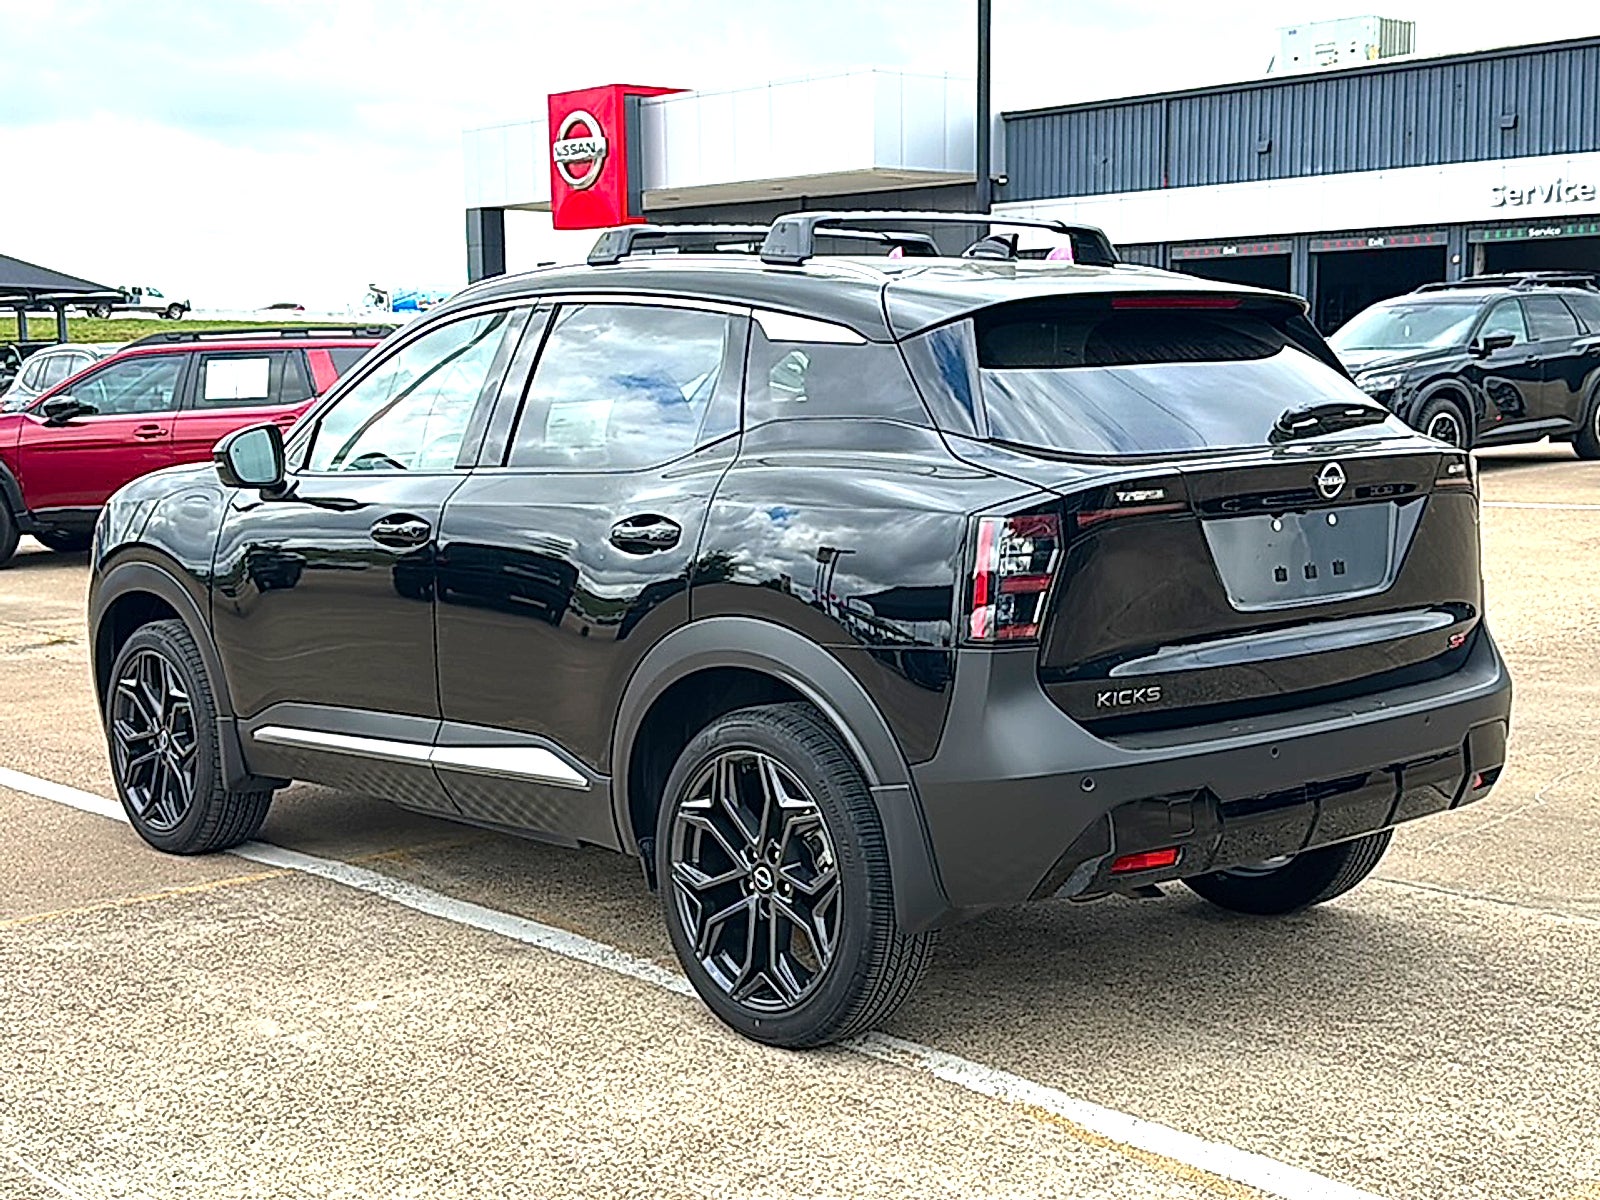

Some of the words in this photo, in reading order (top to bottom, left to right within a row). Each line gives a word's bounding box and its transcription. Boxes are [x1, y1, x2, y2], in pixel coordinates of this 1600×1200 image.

[554, 141, 596, 157] NSSAN
[1489, 177, 1596, 208] Service
[1096, 686, 1161, 708] KICKS
